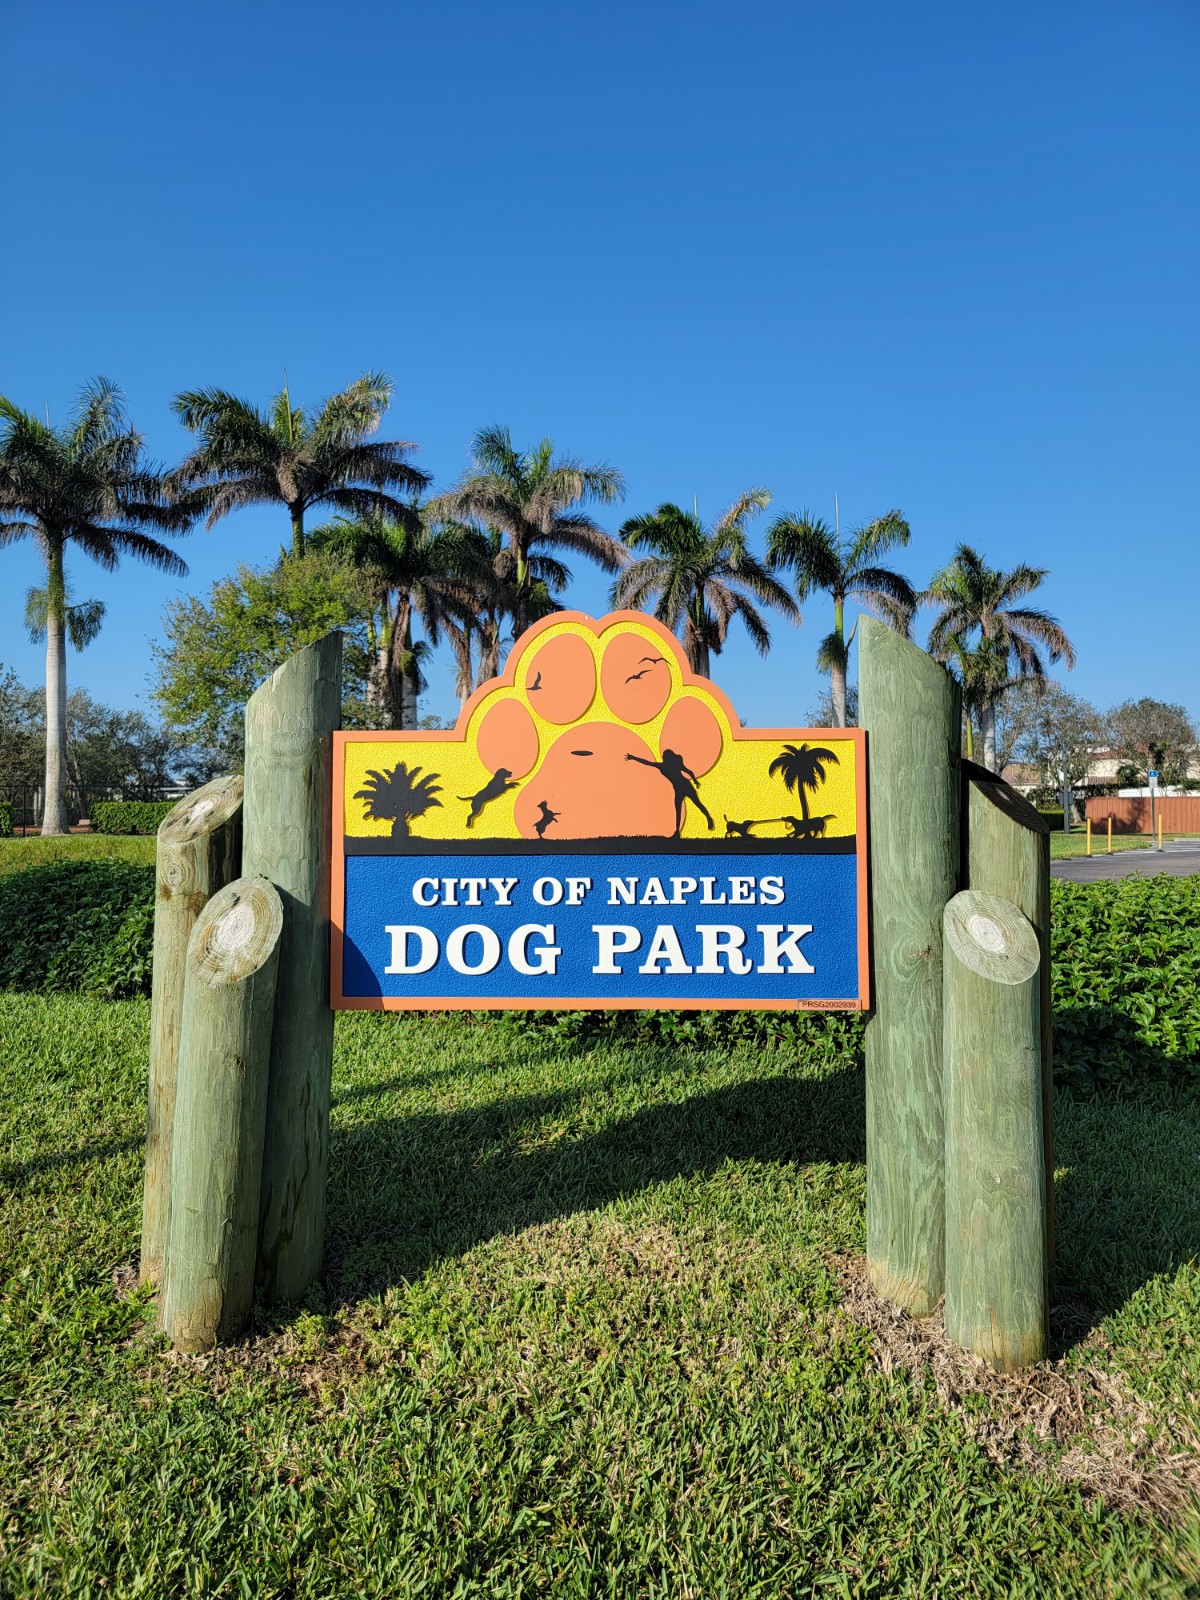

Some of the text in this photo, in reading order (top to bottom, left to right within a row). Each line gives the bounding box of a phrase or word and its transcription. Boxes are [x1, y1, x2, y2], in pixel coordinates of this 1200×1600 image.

[411, 875, 786, 907] CITY OF NAPLES
[384, 923, 815, 976] DOG PARK
